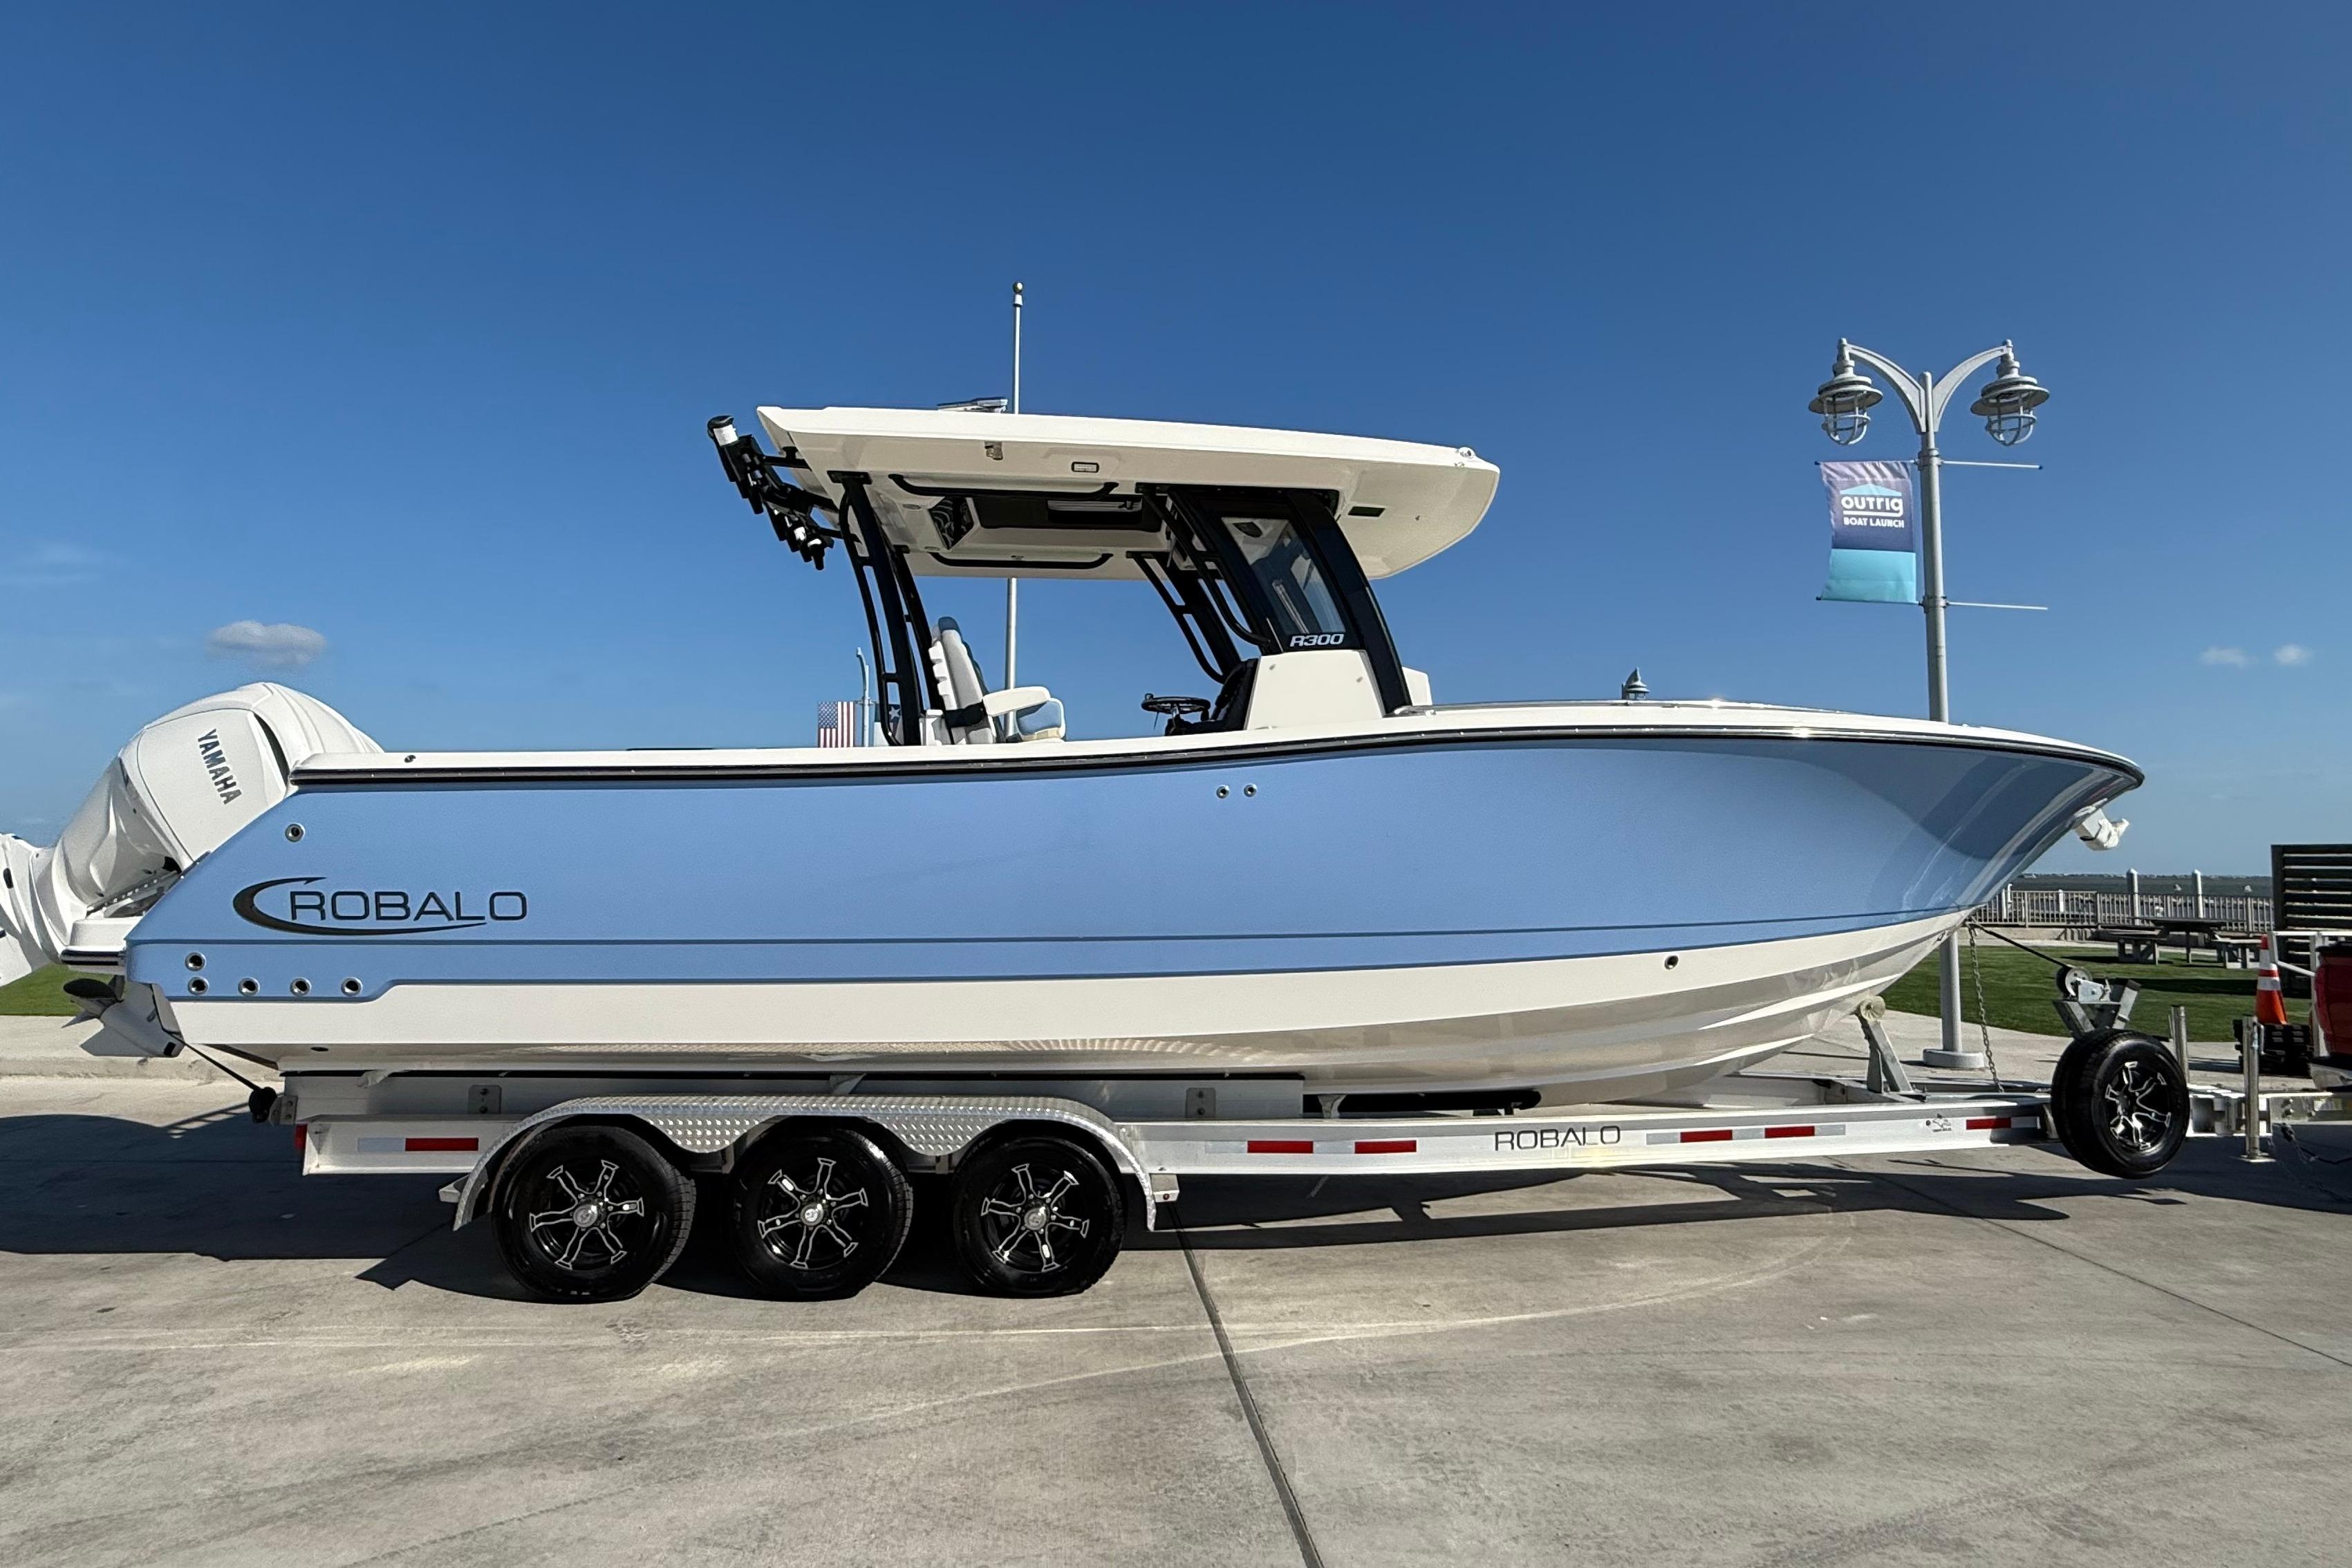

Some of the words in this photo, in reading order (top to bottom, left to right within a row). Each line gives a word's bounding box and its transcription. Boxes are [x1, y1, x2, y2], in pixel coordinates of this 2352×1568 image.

[1844, 518, 1867, 526] BOAT
[1869, 519, 1905, 528] LAUNCH
[1289, 633, 1345, 647] R300
[198, 728, 242, 805] YAMAHA
[290, 890, 527, 921] ROBALO
[1495, 1126, 1621, 1151] ROBALO
